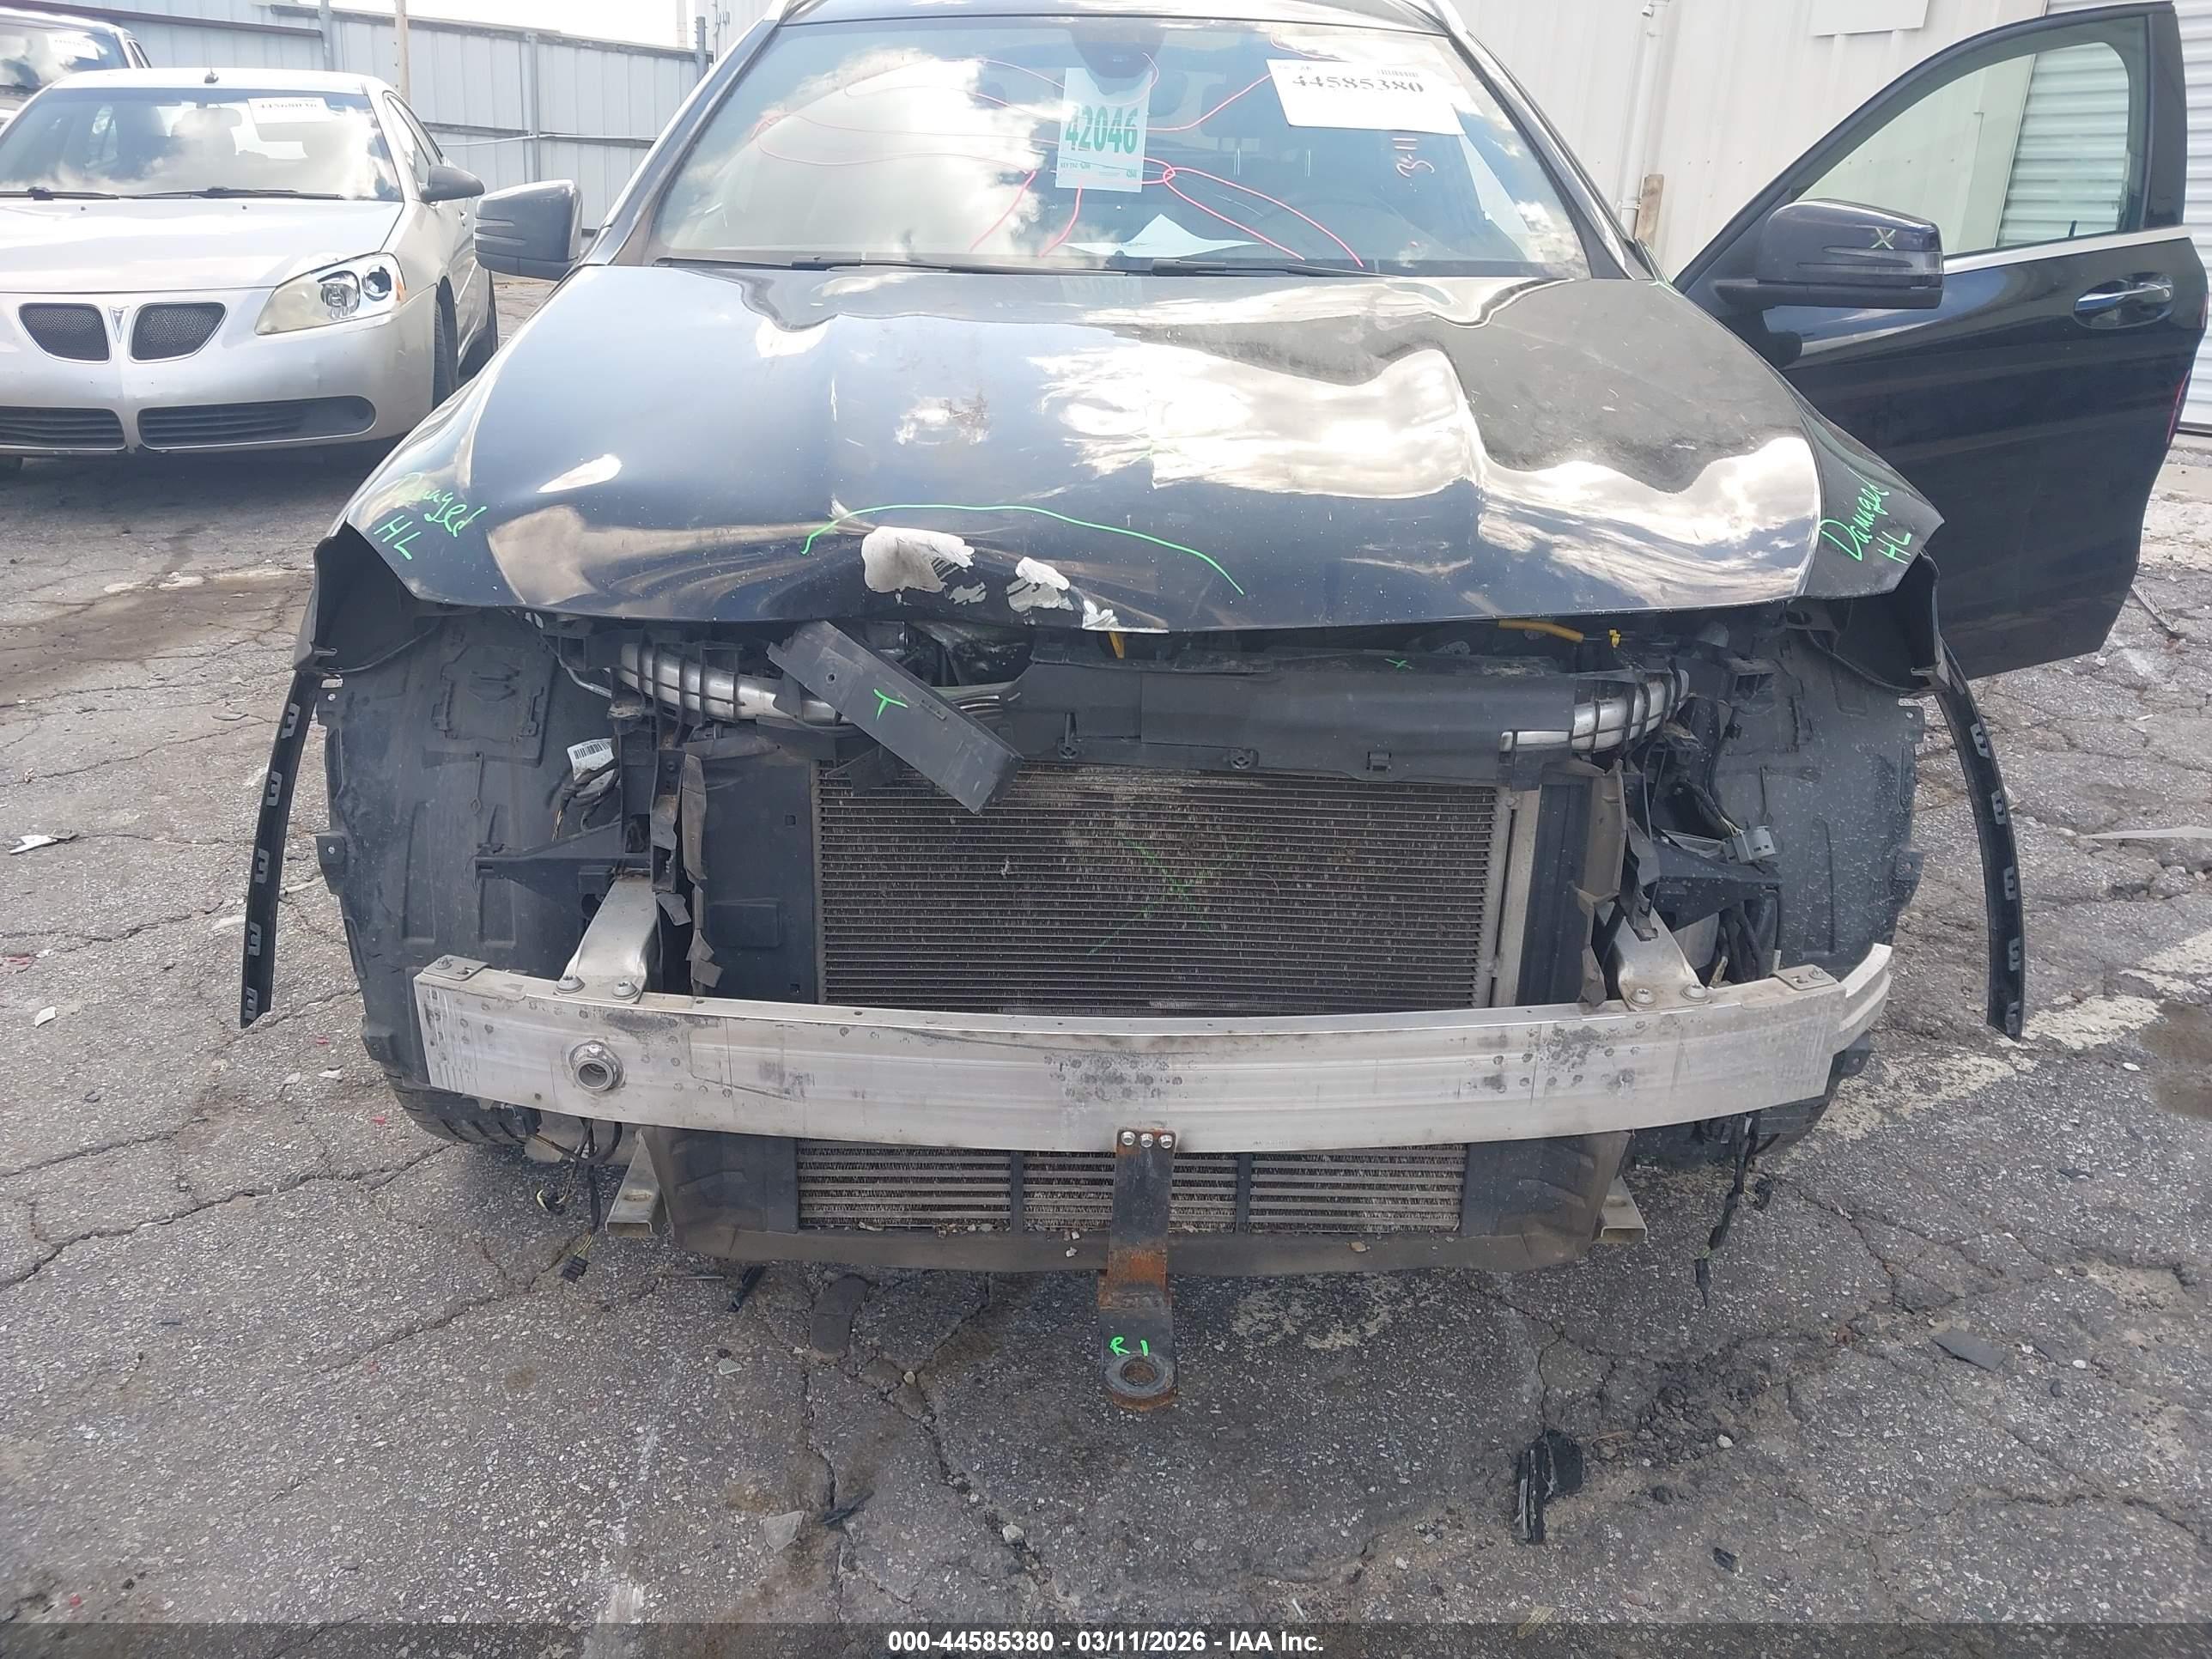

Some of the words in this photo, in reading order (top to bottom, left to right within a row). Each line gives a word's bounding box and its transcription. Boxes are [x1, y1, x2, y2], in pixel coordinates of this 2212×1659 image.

[1292, 75, 1424, 94] 44585380
[1065, 106, 1139, 155] 42046
[374, 514, 422, 561] HL
[1876, 531, 1912, 565] HL
